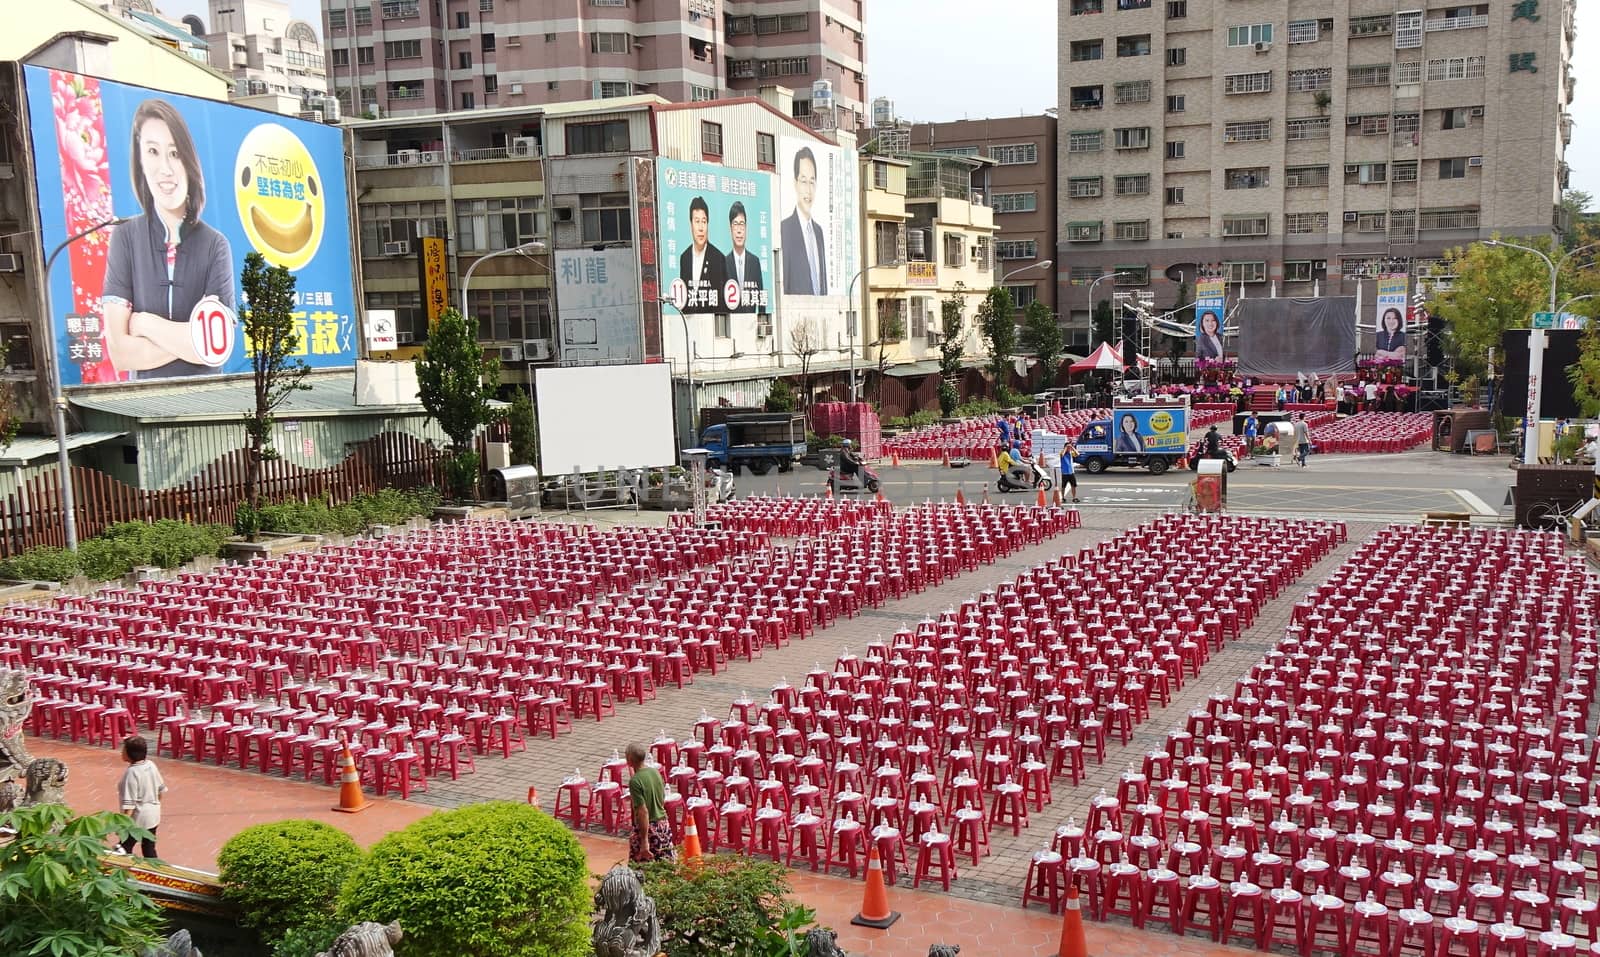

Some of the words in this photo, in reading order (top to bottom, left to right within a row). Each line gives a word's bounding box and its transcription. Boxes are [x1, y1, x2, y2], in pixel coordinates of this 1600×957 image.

[254, 153, 304, 179] 不忘初心
[256, 175, 305, 201] 堅持為您
[561, 256, 608, 284] 利龍
[672, 284, 684, 304] 11
[687, 290, 719, 307] 洪平朗
[727, 283, 737, 303] 2
[67, 317, 100, 333] 懇請
[197, 310, 226, 357] 10
[69, 342, 103, 359] 支持
[1146, 437, 1155, 446] 10
